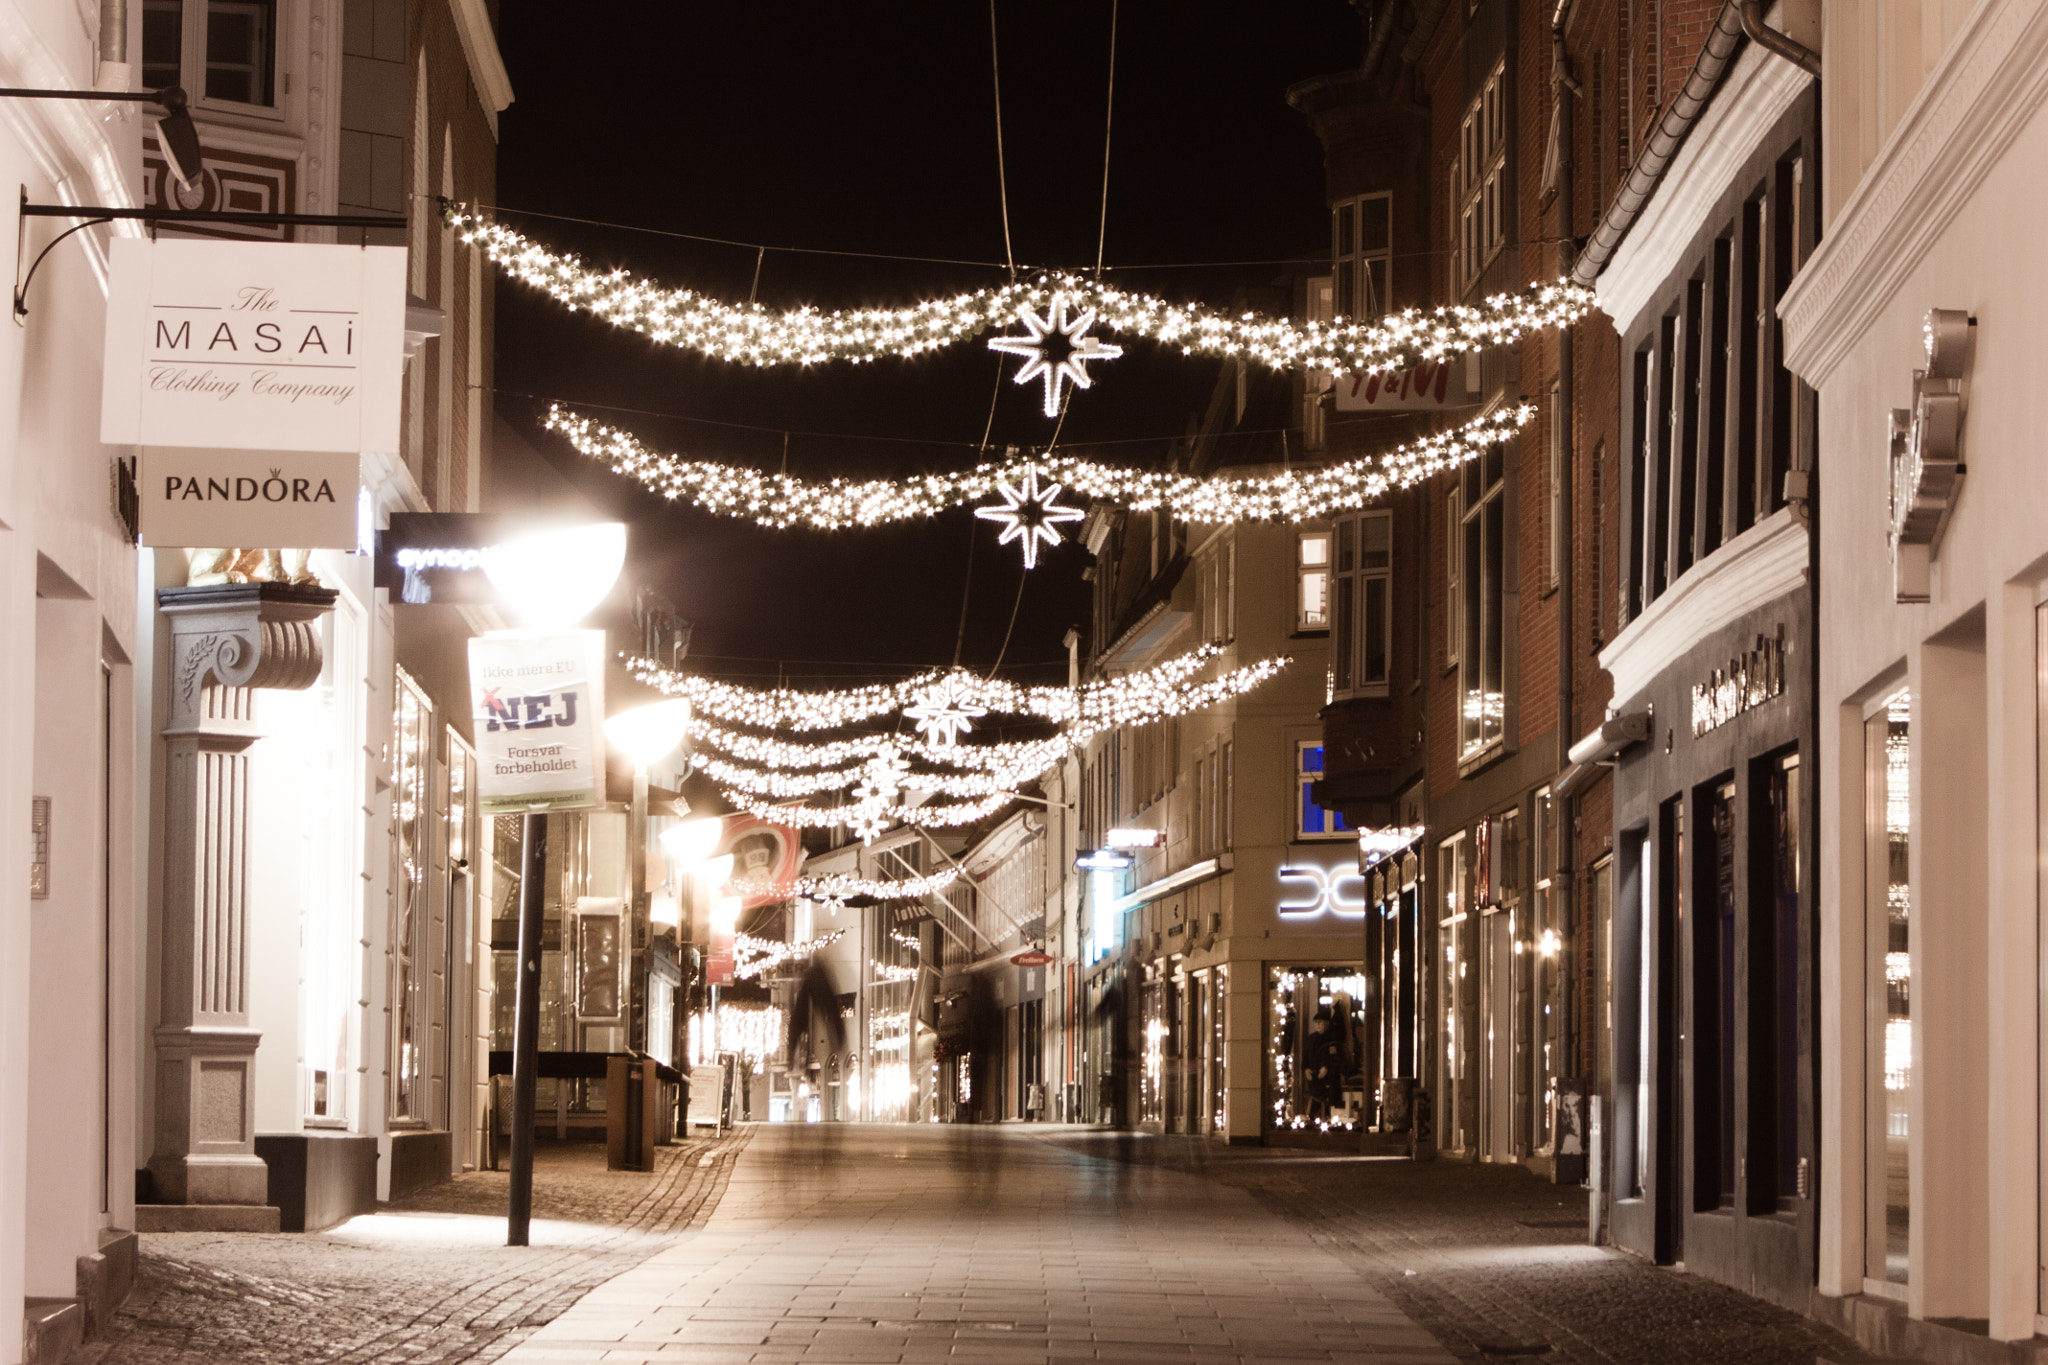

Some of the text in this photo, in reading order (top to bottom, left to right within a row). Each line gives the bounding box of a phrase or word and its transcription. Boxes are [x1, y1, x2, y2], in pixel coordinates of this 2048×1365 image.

[230, 286, 279, 313] The
[149, 366, 355, 405] Clothing Company
[166, 474, 336, 503] PANDORA
[483, 661, 575, 679] Ikke mere EU
[487, 692, 577, 732] NEJ
[507, 745, 563, 758] Forsvar
[495, 759, 577, 775] forbeholdet
